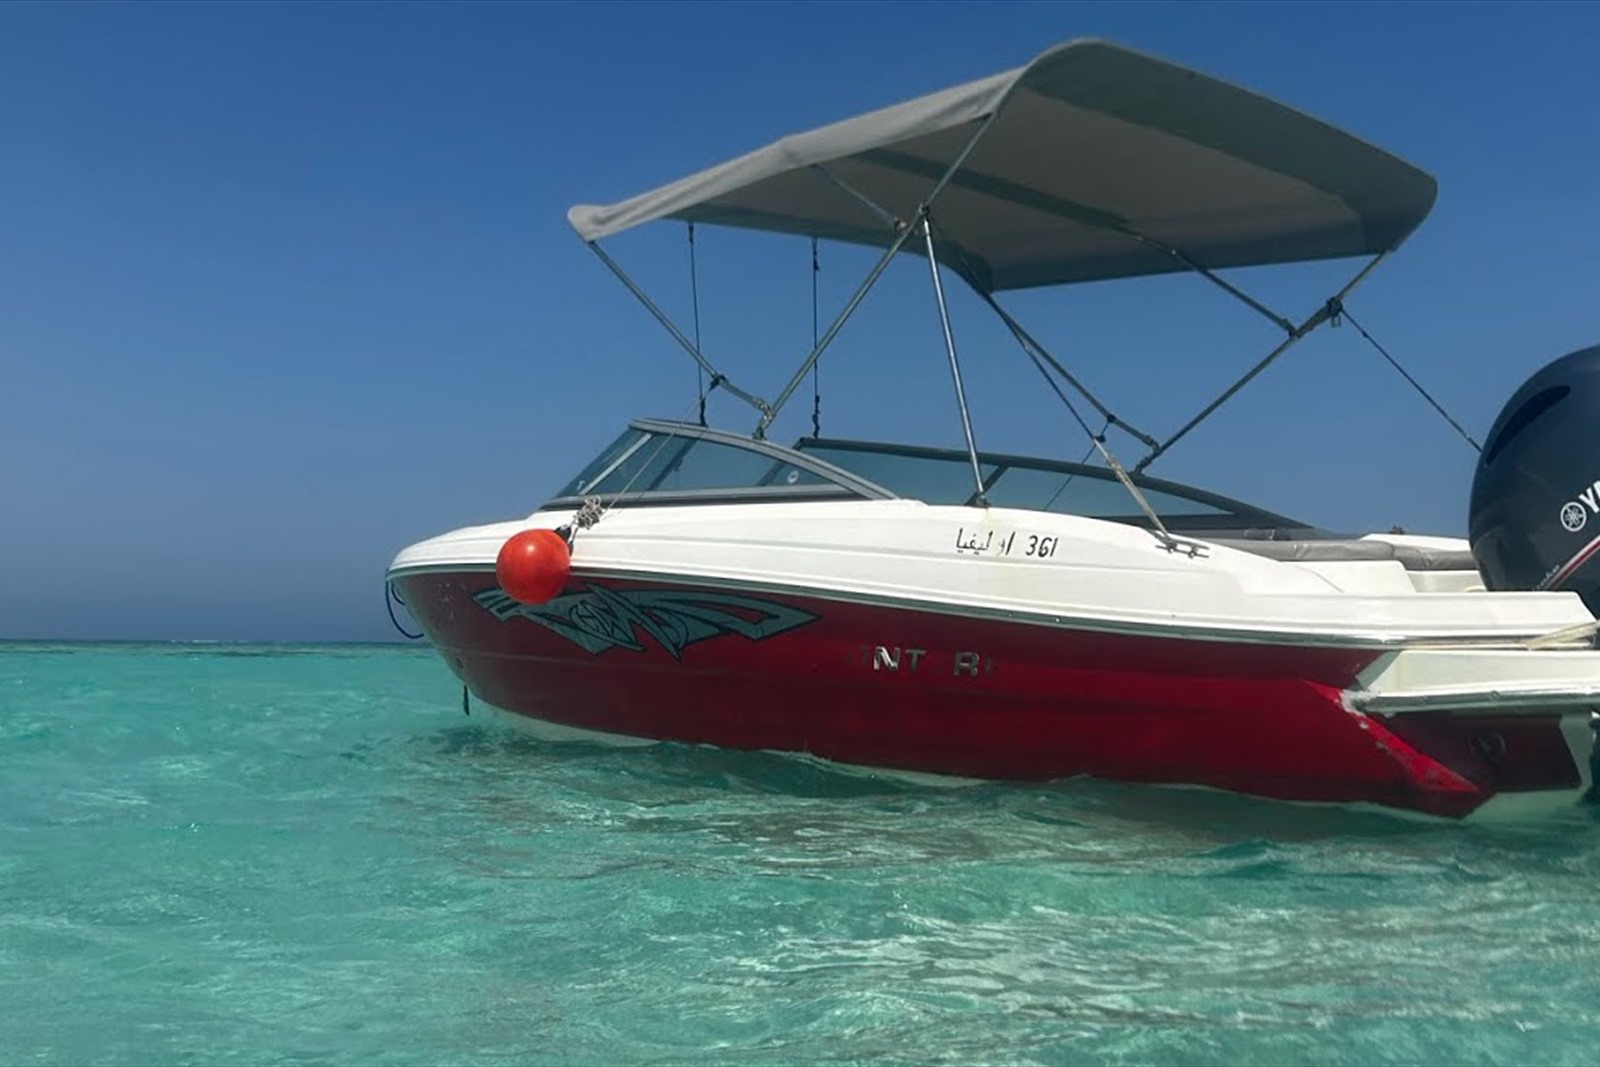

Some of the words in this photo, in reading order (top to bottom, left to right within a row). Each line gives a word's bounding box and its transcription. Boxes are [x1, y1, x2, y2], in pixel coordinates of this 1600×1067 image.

[1025, 534, 1059, 558] 361
[858, 644, 926, 672] NT
[953, 651, 993, 677] R
